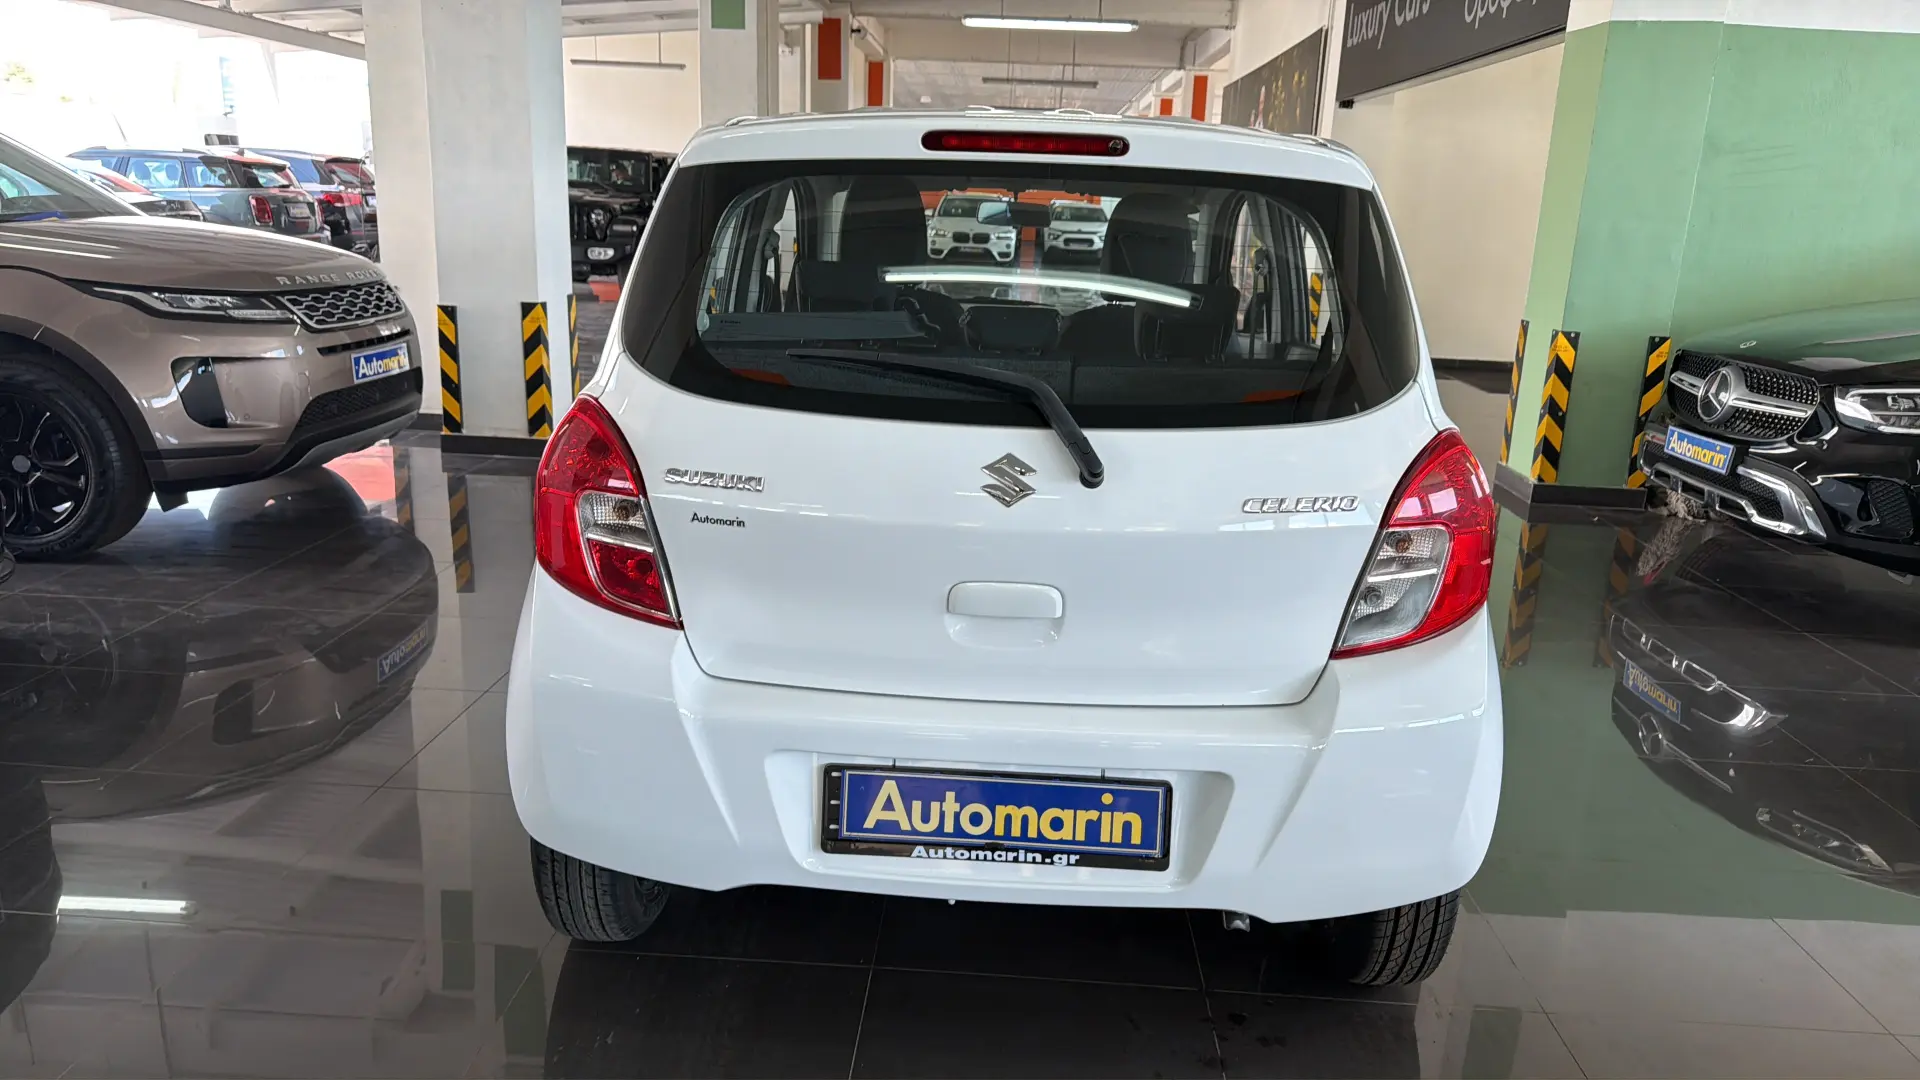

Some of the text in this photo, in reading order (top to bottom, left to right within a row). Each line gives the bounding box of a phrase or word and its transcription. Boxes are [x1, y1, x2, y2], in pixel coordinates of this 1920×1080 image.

[1347, 0, 1391, 50] Luxury
[276, 273, 341, 285] RANGE
[1668, 431, 1725, 468] Automarin
[664, 468, 764, 492] SUZUKI
[1242, 495, 1359, 514] CELERIO
[691, 512, 745, 527] Automarin
[863, 779, 1142, 845] Automarin
[911, 845, 1080, 866] Automarin.gr
